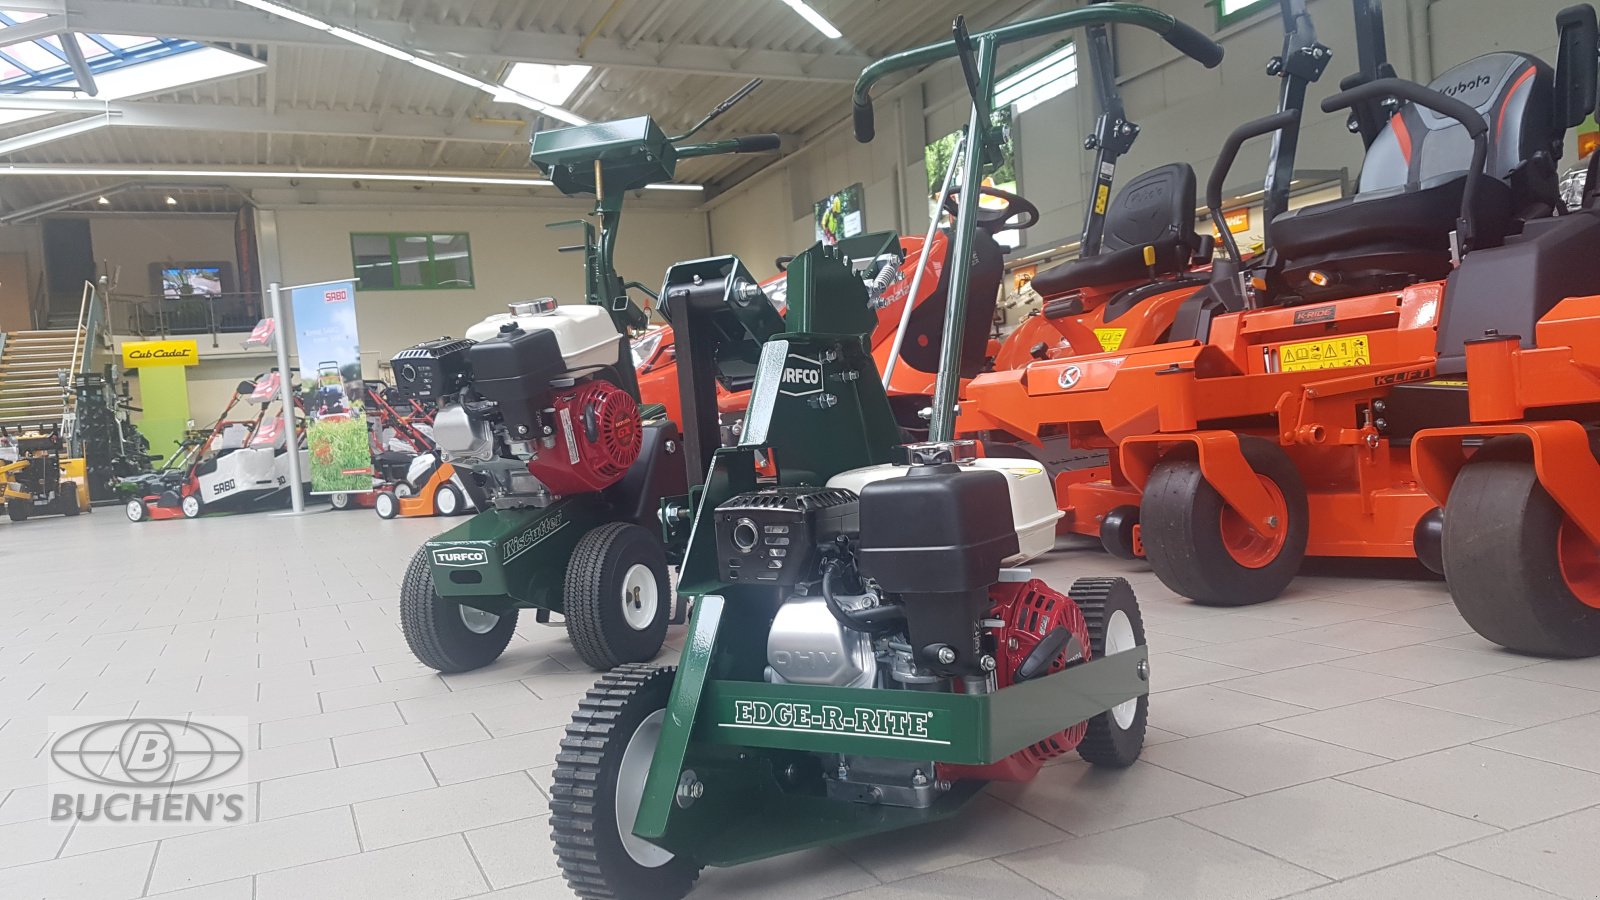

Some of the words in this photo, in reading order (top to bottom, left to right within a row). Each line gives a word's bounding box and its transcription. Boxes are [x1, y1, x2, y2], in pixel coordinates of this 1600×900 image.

[325, 290, 347, 302] SABO
[129, 350, 152, 358] Cub
[153, 349, 191, 358] Cadet
[782, 367, 820, 384] RFCO
[1376, 369, 1427, 385] K-LIFT
[213, 478, 236, 495] SABO
[437, 552, 483, 561] TURFCO
